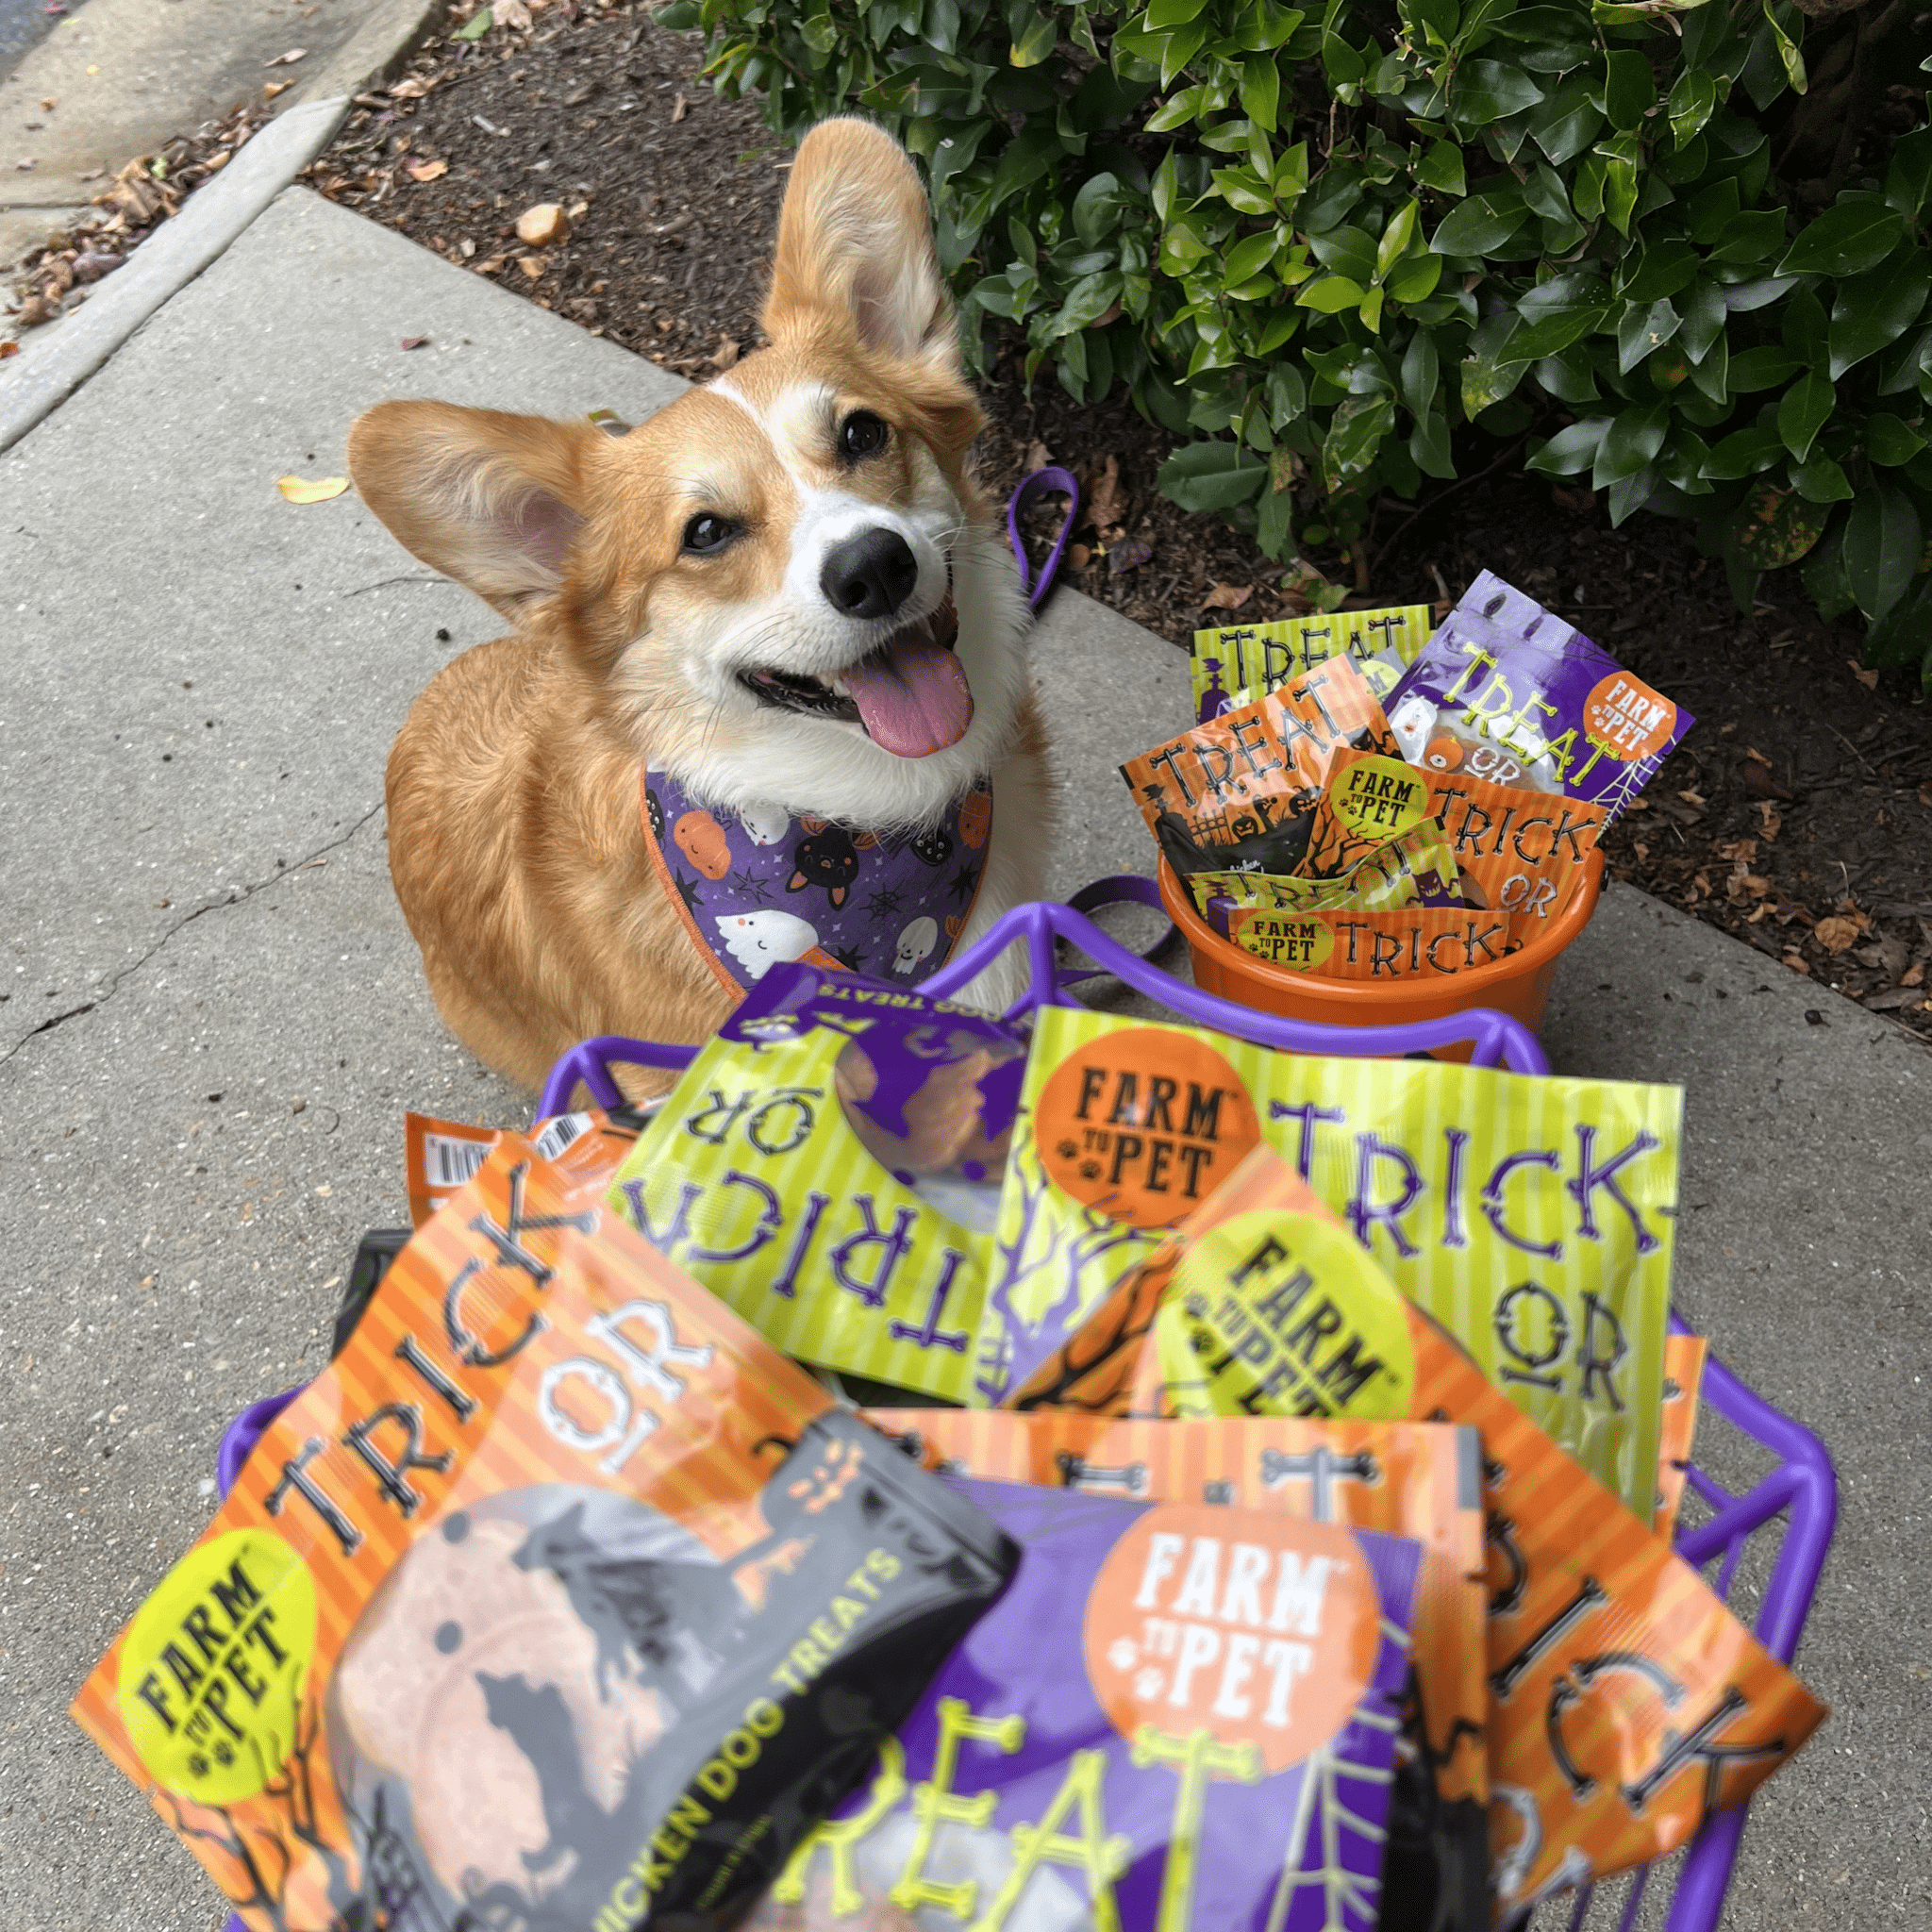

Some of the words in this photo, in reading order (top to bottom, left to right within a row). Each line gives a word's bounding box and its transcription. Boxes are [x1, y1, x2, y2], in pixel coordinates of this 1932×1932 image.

[1149, 675, 1341, 808] TREAT
[1443, 641, 1621, 787] TREAT
[1602, 713, 1649, 752] PET
[1606, 679, 1668, 732] FARM
[1348, 770, 1414, 803] FARM
[1464, 746, 1520, 786] OR
[1351, 793, 1362, 803] TO
[1359, 795, 1405, 826] PET
[1434, 788, 1595, 865] TRICK
[1253, 921, 1316, 939] FARM
[1498, 874, 1557, 918] OR
[1259, 937, 1272, 948] TO
[1272, 938, 1314, 961] PET
[1336, 921, 1503, 975] TRICK
[817, 983, 925, 1009] TREATS
[685, 1086, 824, 1157] OR
[1075, 1067, 1224, 1141] FARM
[1107, 1133, 1213, 1199] PET
[1269, 1100, 1658, 1260] TRICK
[264, 1159, 602, 1557] TRICK
[1229, 1233, 1385, 1407] FARM
[1494, 1280, 1630, 1413] OR
[537, 1299, 714, 1474] OR
[1134, 1533, 1330, 1637] FARM
[136, 1558, 262, 1734] FARM
[200, 1607, 288, 1740] PET
[1167, 1624, 1312, 1727] PET
[591, 1792, 714, 1932] ICKEN
[696, 1697, 785, 1803] DOG
[771, 1547, 903, 1695] TREATS
[773, 1695, 1265, 1932] REAT
